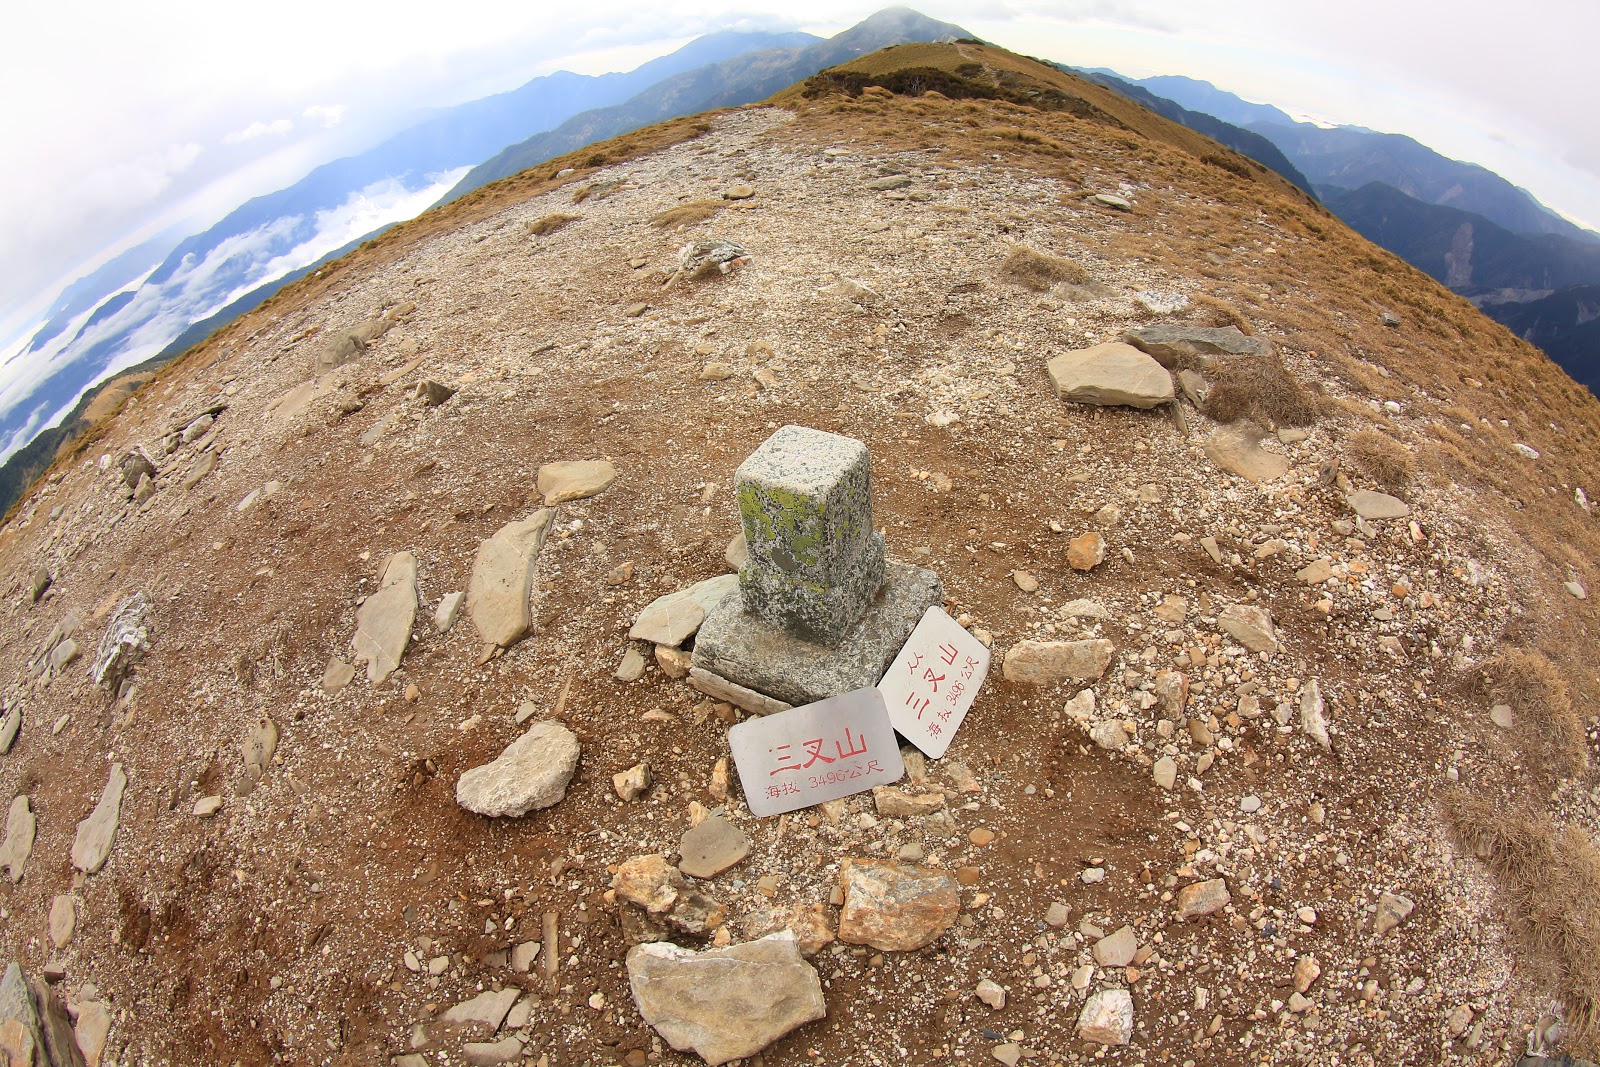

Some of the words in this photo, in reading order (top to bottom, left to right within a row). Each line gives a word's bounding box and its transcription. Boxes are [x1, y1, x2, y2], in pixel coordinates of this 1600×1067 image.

[905, 643, 960, 719] 三叉山
[767, 727, 868, 776] 三叉山
